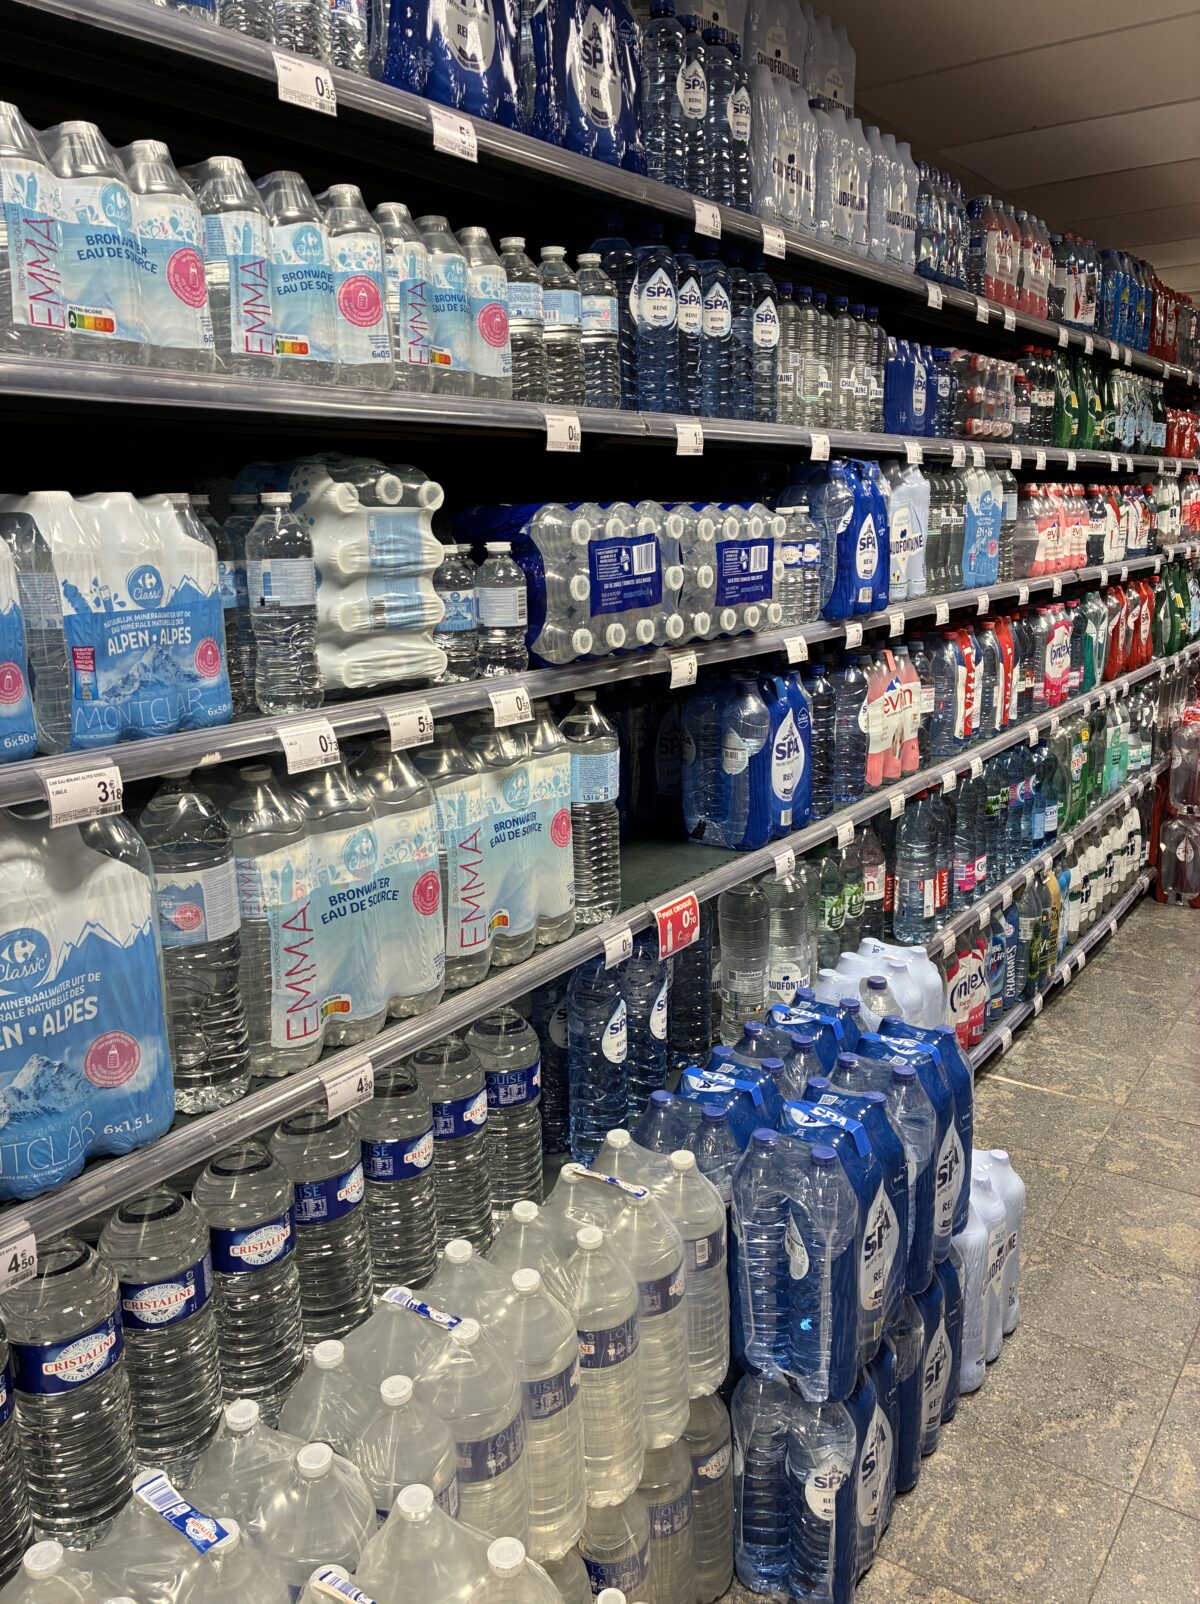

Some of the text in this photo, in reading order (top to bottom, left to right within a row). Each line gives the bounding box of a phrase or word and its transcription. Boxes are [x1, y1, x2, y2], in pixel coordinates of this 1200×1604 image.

[684, 79, 706, 92] SPA
[77, 247, 158, 275] EAU DE SOURCE
[23, 218, 66, 329] EMMA
[277, 281, 314, 295] EAU DE
[646, 287, 673, 299] SPA
[680, 294, 701, 306] SPA
[240, 259, 275, 356] EMMA
[447, 303, 457, 311] DE
[704, 299, 729, 310] SPA
[407, 282, 430, 365] EMMA
[756, 313, 777, 324] SPA
[107, 627, 192, 656] ALPEN ALPES
[74, 687, 206, 734] MONTCLAR
[775, 736, 801, 761] SPA
[489, 834, 506, 848] EAU
[507, 830, 521, 841] DE
[459, 826, 487, 948] EMMA
[320, 889, 400, 925] EAU DE SOURCE
[662, 909, 674, 919] PRIX
[71, 974, 86, 987] UIT
[88, 972, 101, 982] DE
[282, 900, 319, 1041] EMMA
[1005, 944, 1017, 998] CHARMES
[27, 993, 69, 1016] NATURELLE
[69, 985, 85, 998] DES
[42, 996, 98, 1037] ALPES
[702, 1071, 736, 1085] SPA
[103, 1113, 153, 1135] 6x1,5 L
[809, 1106, 848, 1126] SPA
[231, 1229, 290, 1256] CRISTALINE
[124, 1286, 194, 1310] CRISTALINE
[82, 1334, 105, 1345] SOURCE
[44, 1336, 115, 1375] CRISTALINE
